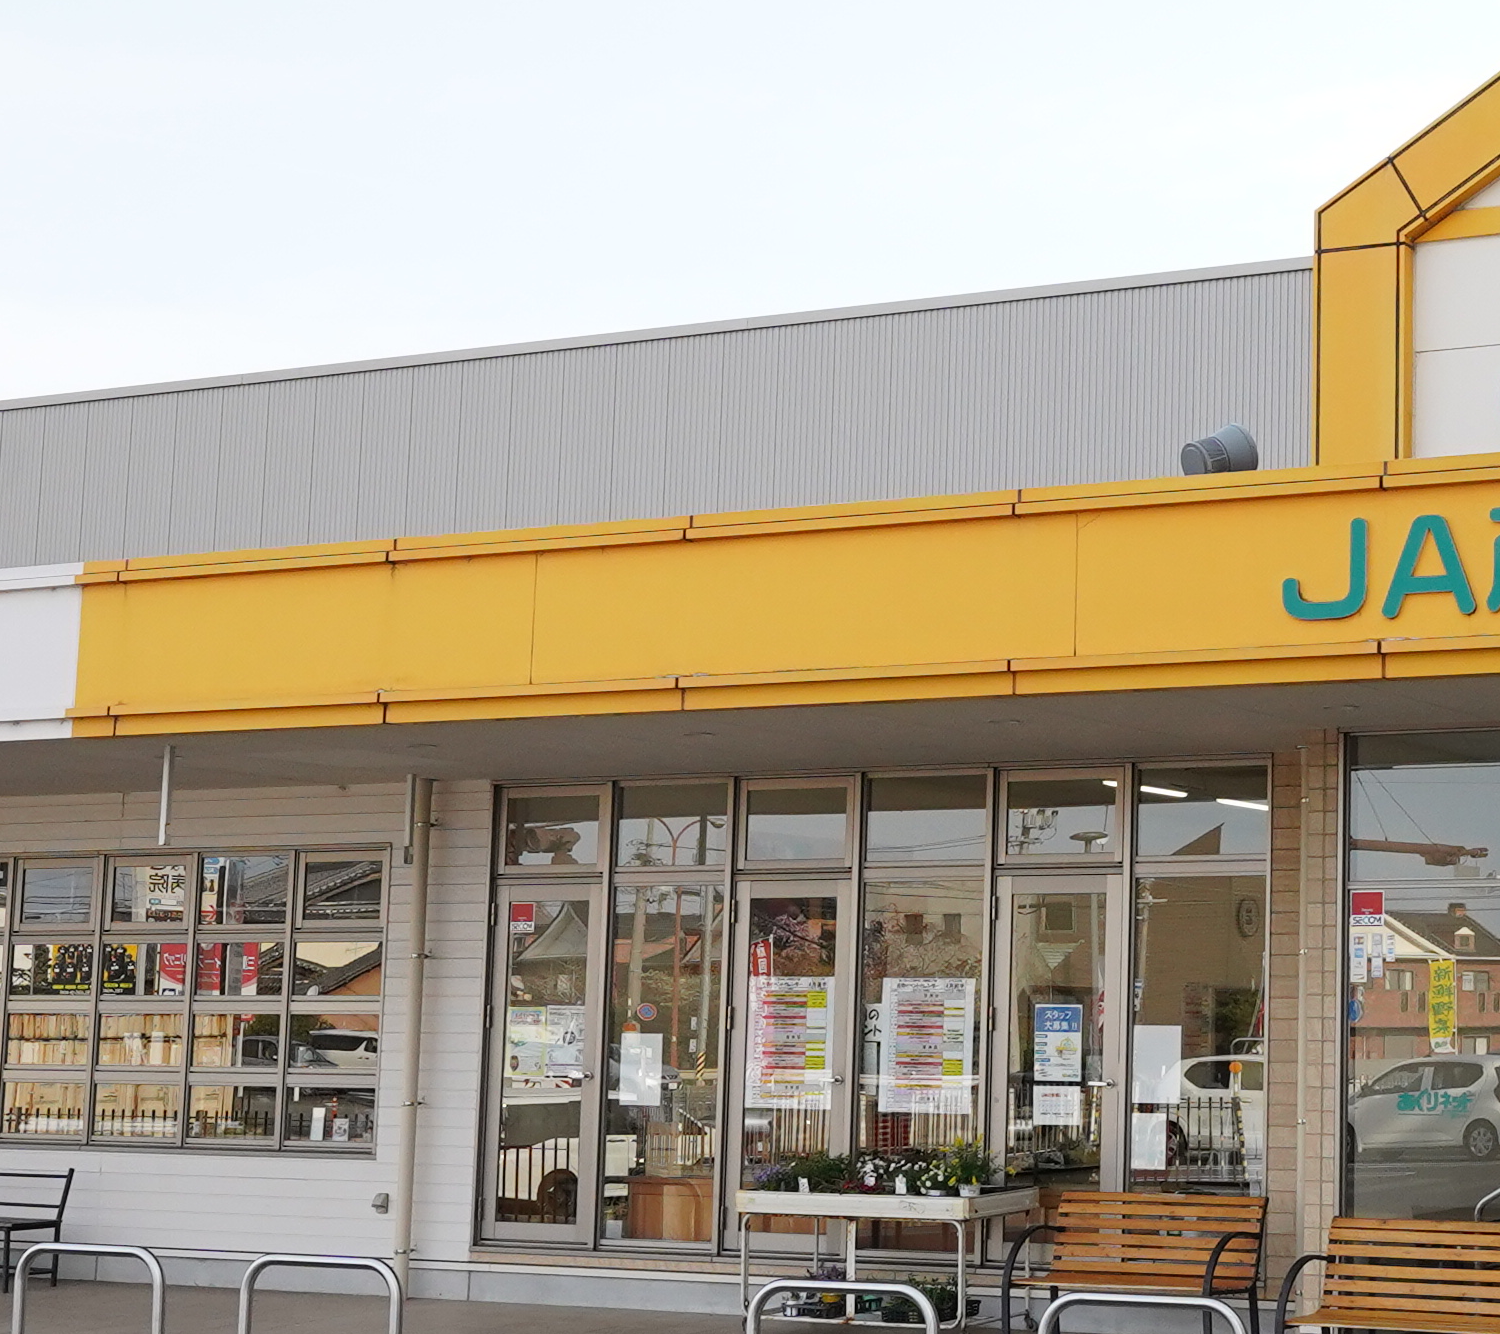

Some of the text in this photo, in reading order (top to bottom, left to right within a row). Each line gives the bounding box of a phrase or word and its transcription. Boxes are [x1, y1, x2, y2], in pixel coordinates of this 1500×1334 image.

[1352, 915, 1382, 925] SECOM
[1430, 966, 1455, 1034] 新鮮野菜
[1044, 1010, 1072, 1020] スタッフ
[1044, 1020, 1069, 1031] 大募集
